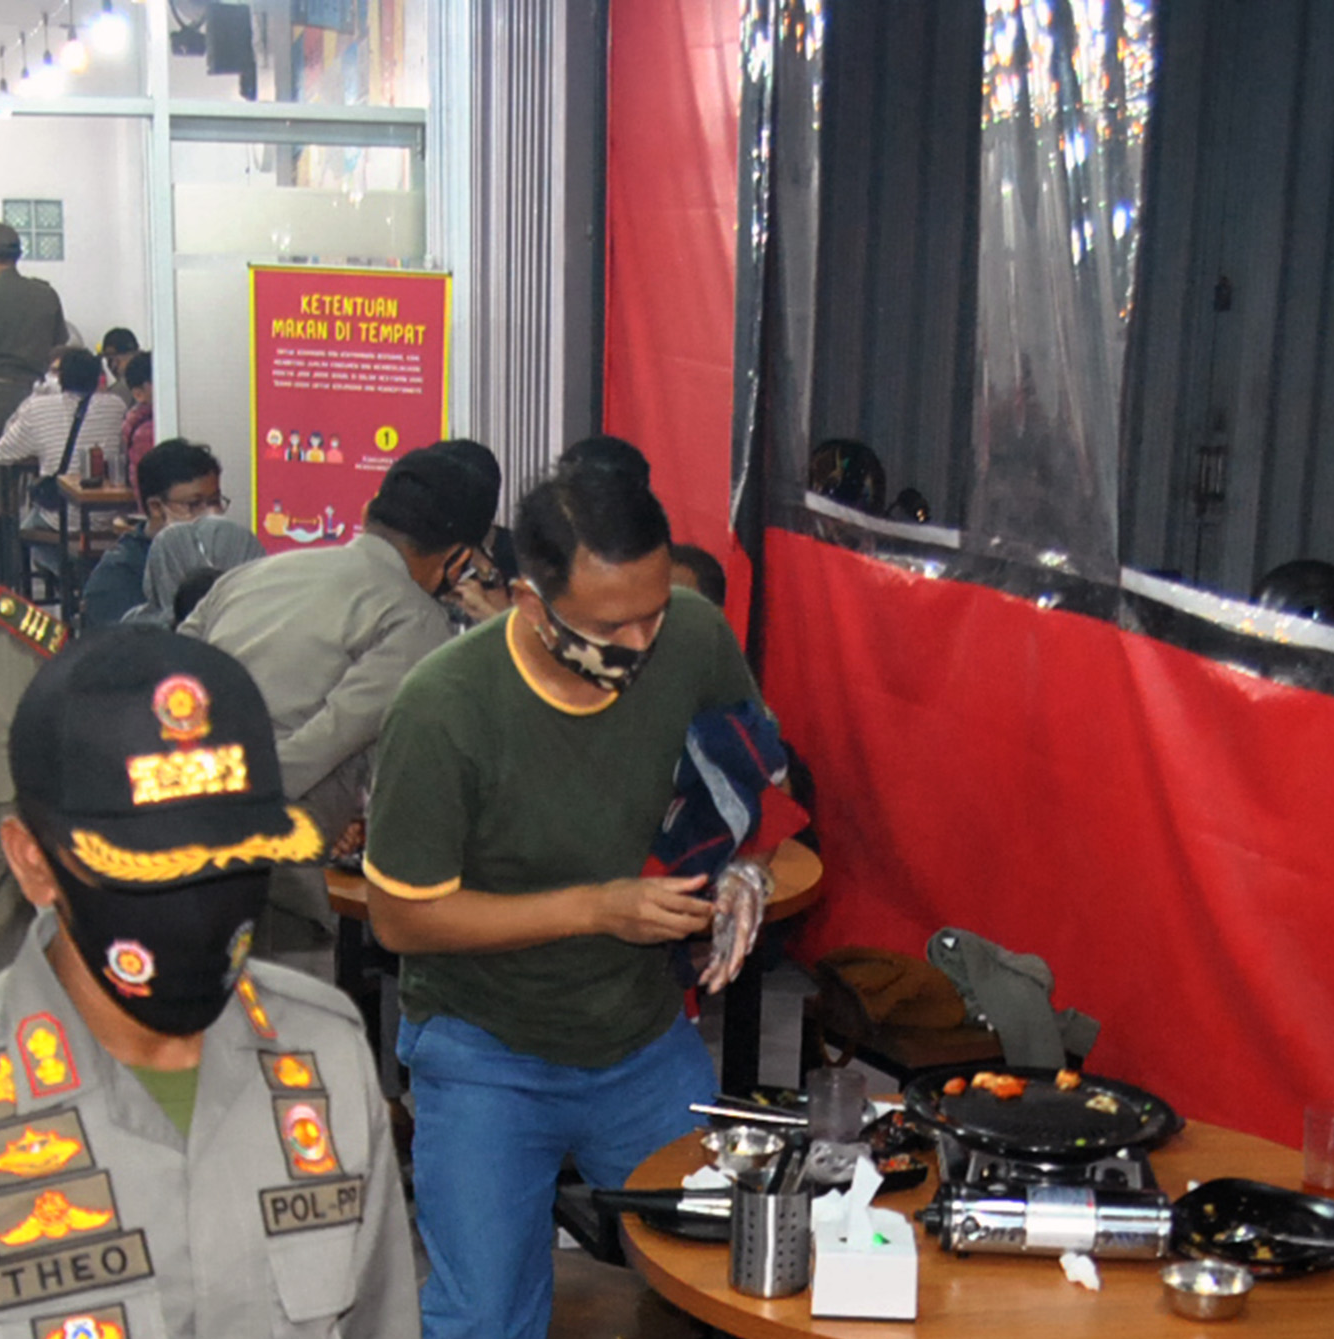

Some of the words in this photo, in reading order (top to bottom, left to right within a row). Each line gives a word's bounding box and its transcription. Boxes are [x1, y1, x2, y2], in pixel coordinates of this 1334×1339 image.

[300, 294, 398, 318] KETENTUAN
[271, 318, 329, 340] MAKAN
[335, 320, 351, 341] DI
[359, 322, 426, 345] TEMPAT
[270, 1186, 357, 1227] POL-PP
[1, 1245, 127, 1297] THEO
